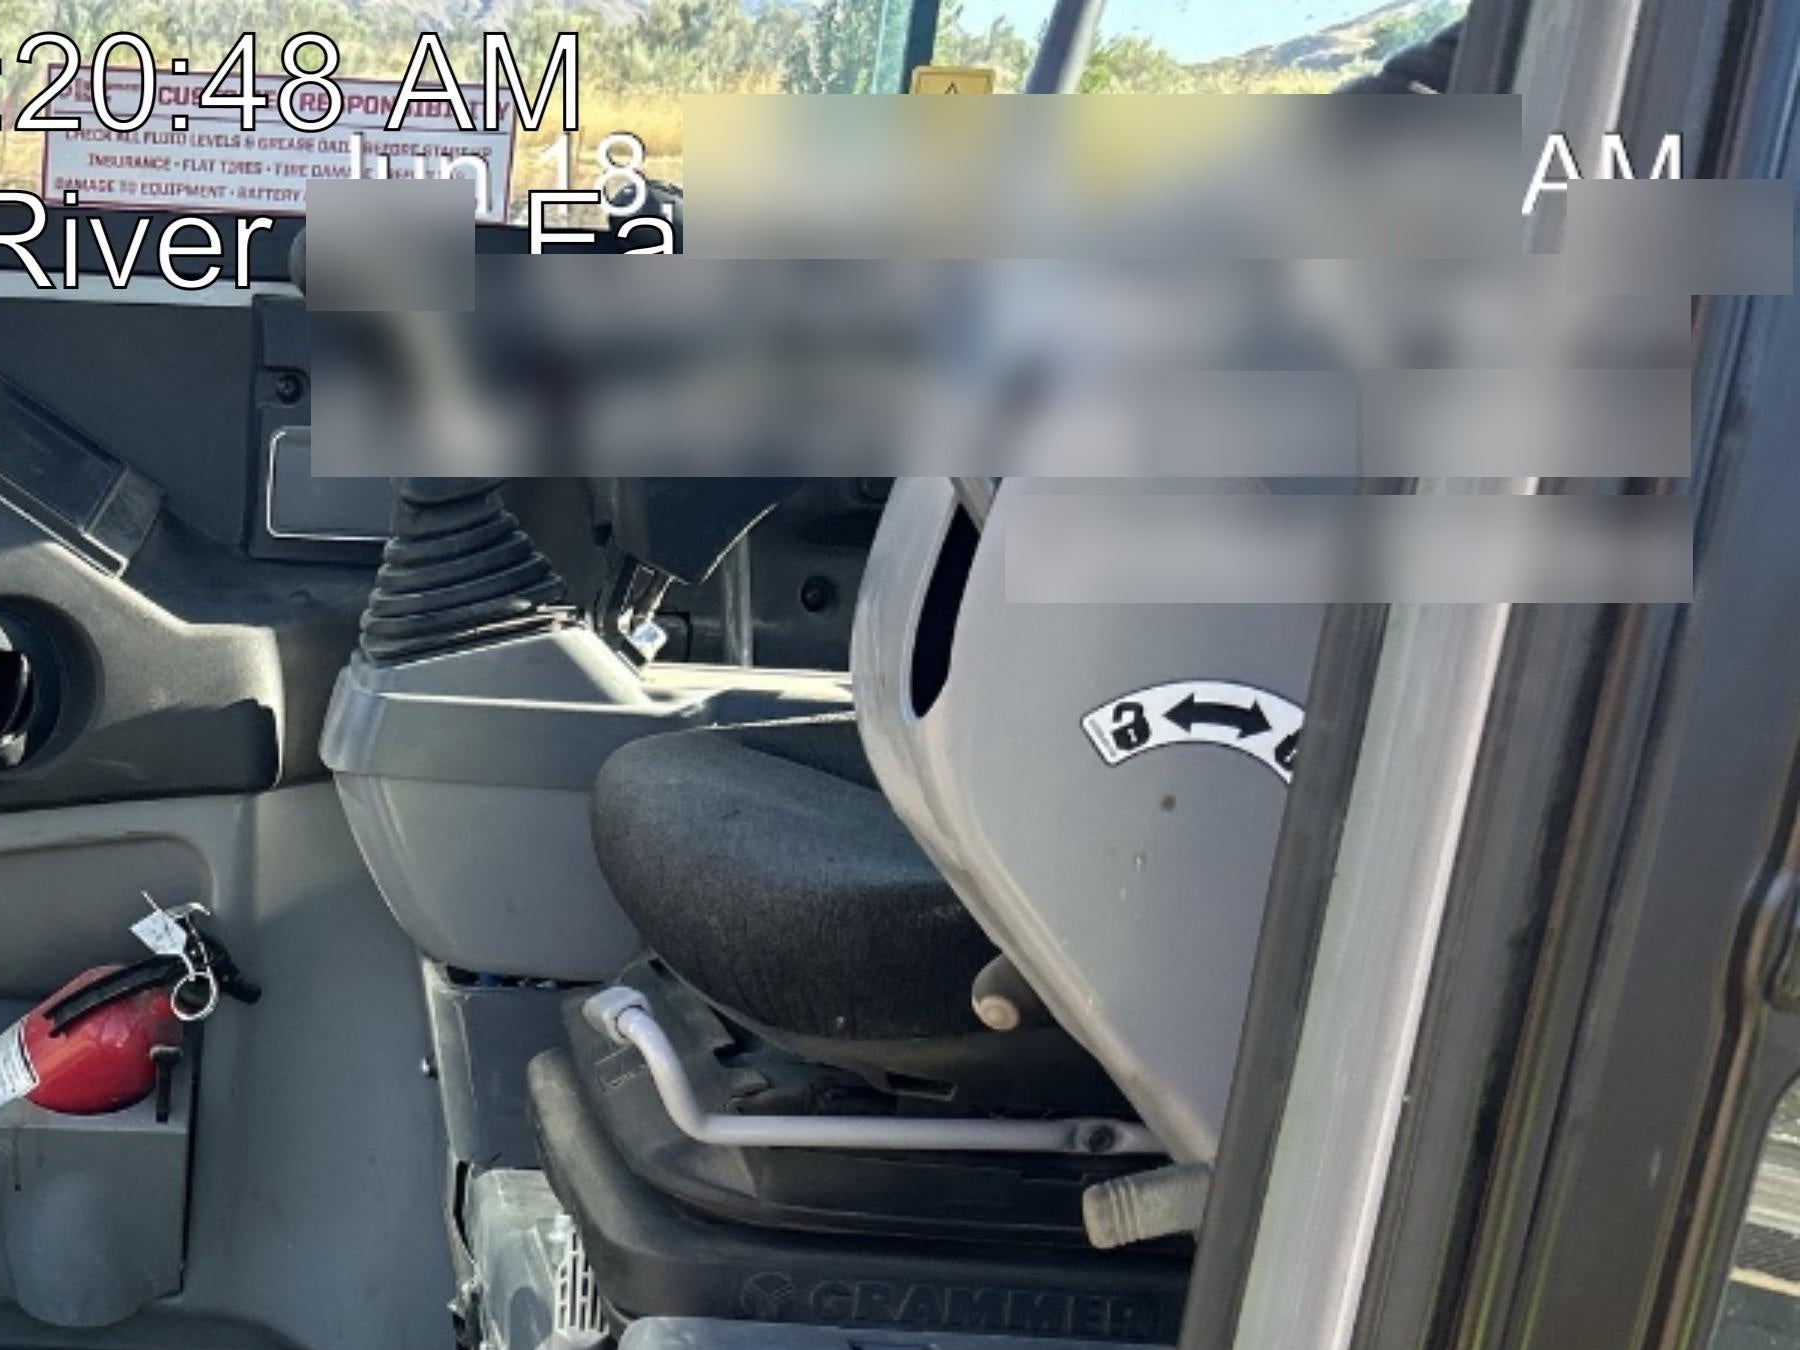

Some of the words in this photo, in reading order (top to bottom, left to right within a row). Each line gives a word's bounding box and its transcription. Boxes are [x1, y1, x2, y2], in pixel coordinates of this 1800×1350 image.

[144, 131, 187, 146] FLUID
[191, 133, 241, 148] LEVELS
[257, 137, 315, 151] GREASE
[88, 152, 172, 172] INSURANCE
[181, 157, 217, 173] FLAT
[221, 159, 262, 175] TIRES
[141, 183, 226, 199] EQUIPMENT
